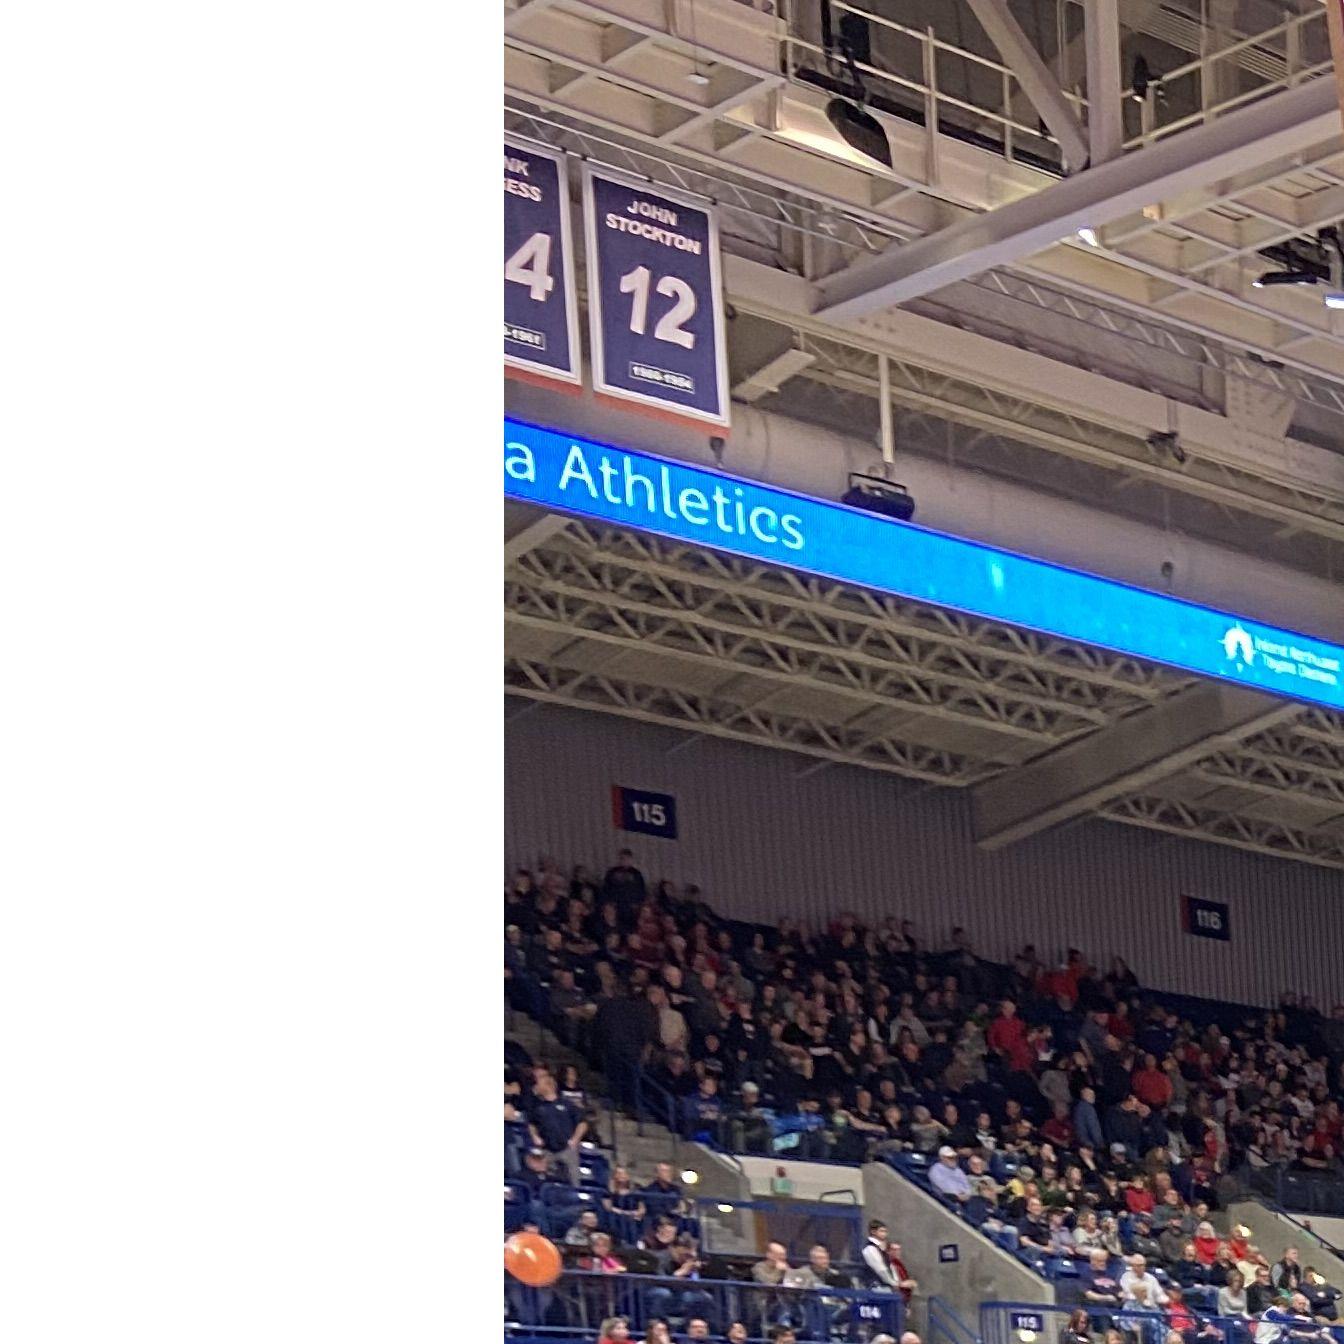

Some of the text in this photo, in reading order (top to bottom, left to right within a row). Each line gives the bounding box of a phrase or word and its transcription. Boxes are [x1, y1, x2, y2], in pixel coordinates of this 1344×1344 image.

[504, 181, 542, 202] ESS
[627, 200, 678, 226] JOHN
[606, 213, 702, 255] STOCKTON
[620, 265, 698, 350] 12
[504, 442, 806, 551] a Athletics
[631, 800, 666, 826] 115
[1196, 908, 1222, 930] 116
